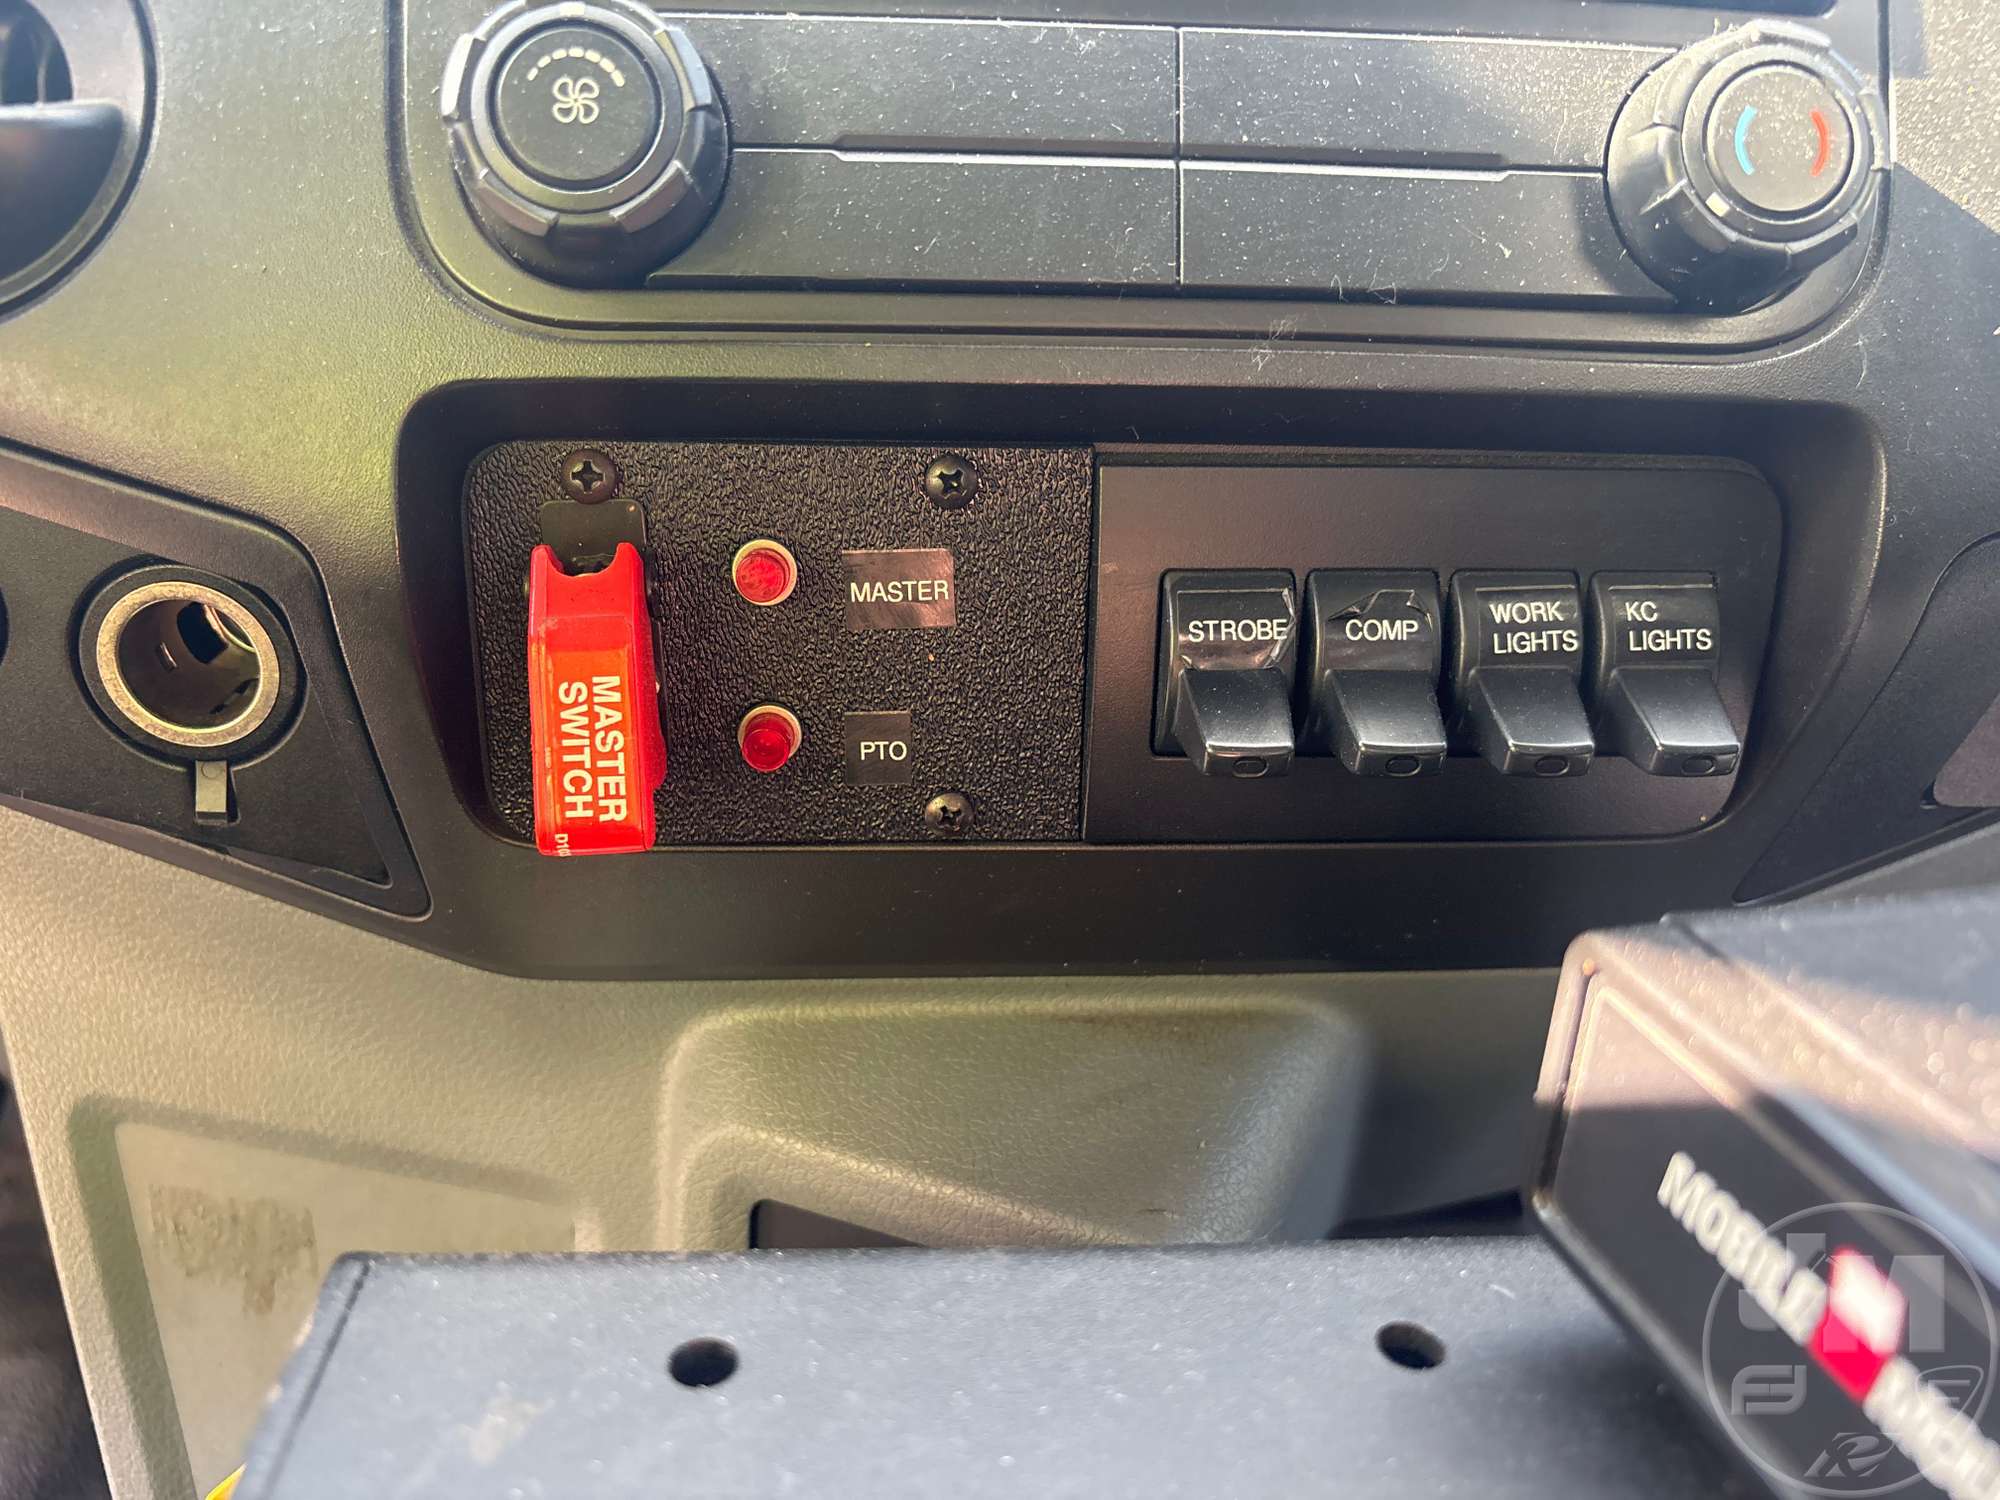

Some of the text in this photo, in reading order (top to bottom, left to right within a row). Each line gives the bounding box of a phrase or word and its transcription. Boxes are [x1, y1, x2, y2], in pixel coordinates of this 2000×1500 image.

[849, 579, 950, 603] MASTER
[1489, 601, 1565, 625] WORK
[1625, 601, 1659, 623] KC
[1187, 618, 1288, 642] STROBE
[1345, 618, 1419, 641] COMP
[1493, 629, 1579, 654] LIGHTS
[1628, 628, 1712, 652] LIGHTS
[558, 681, 593, 819] SWITCH
[591, 675, 628, 823] MASTER
[860, 740, 908, 761] PTO
